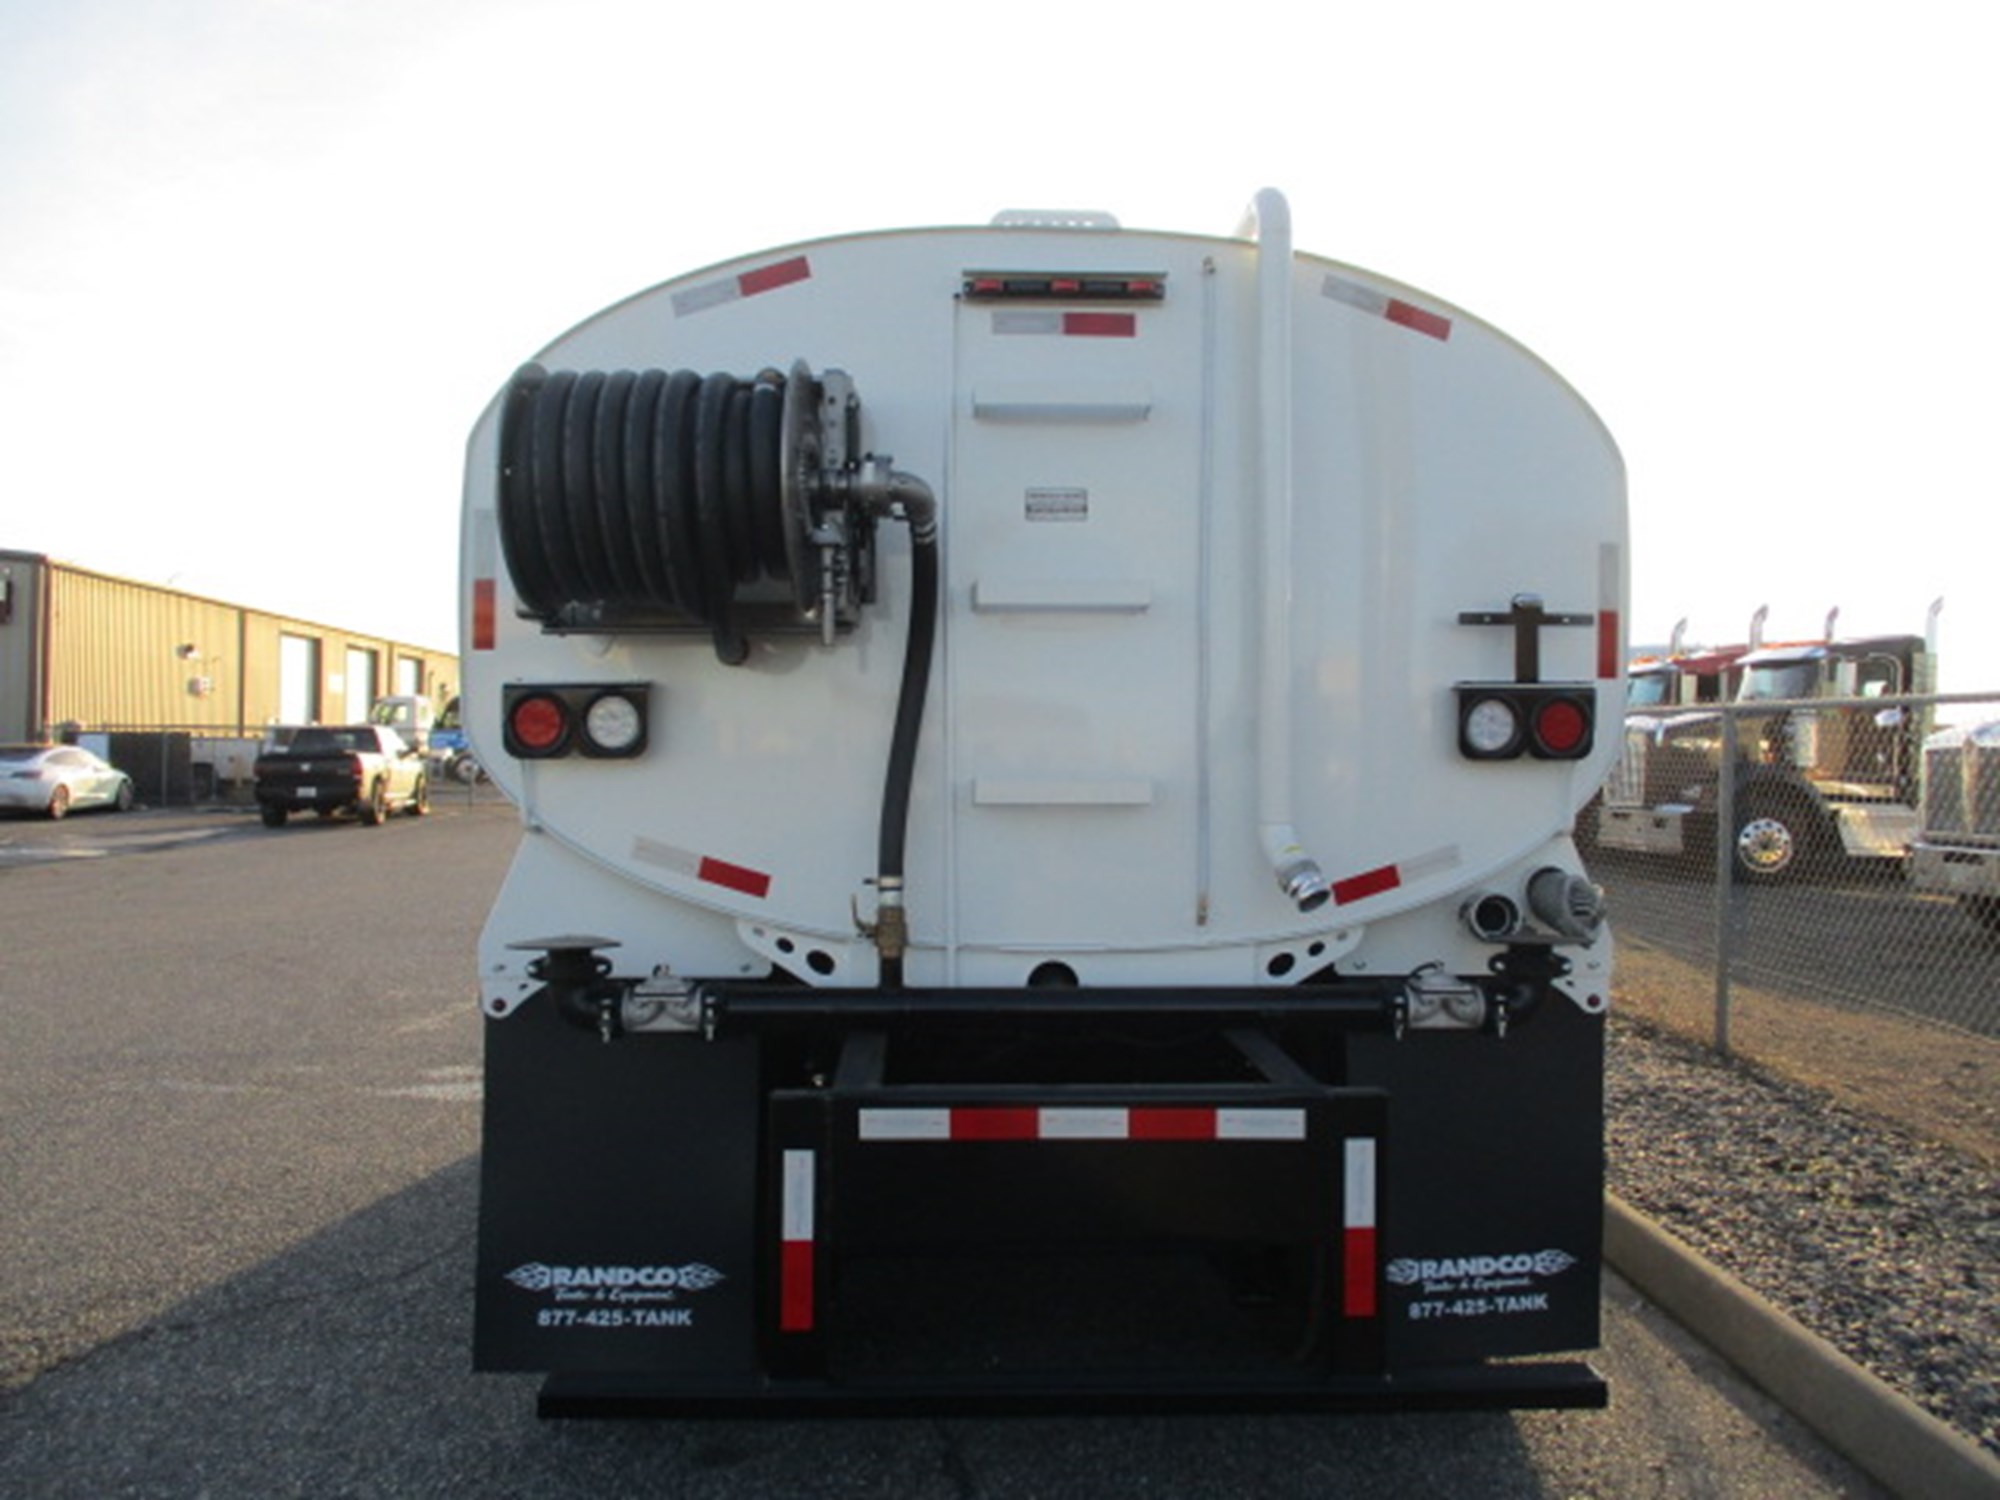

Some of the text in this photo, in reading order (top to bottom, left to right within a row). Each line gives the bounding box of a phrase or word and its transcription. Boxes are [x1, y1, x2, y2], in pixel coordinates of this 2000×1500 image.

[552, 1267, 677, 1286] RANDCO
[1421, 1254, 1533, 1279] RANDCO
[537, 1308, 693, 1327] 877-425-TANK
[1408, 1294, 1549, 1320] 877-425-TANK
